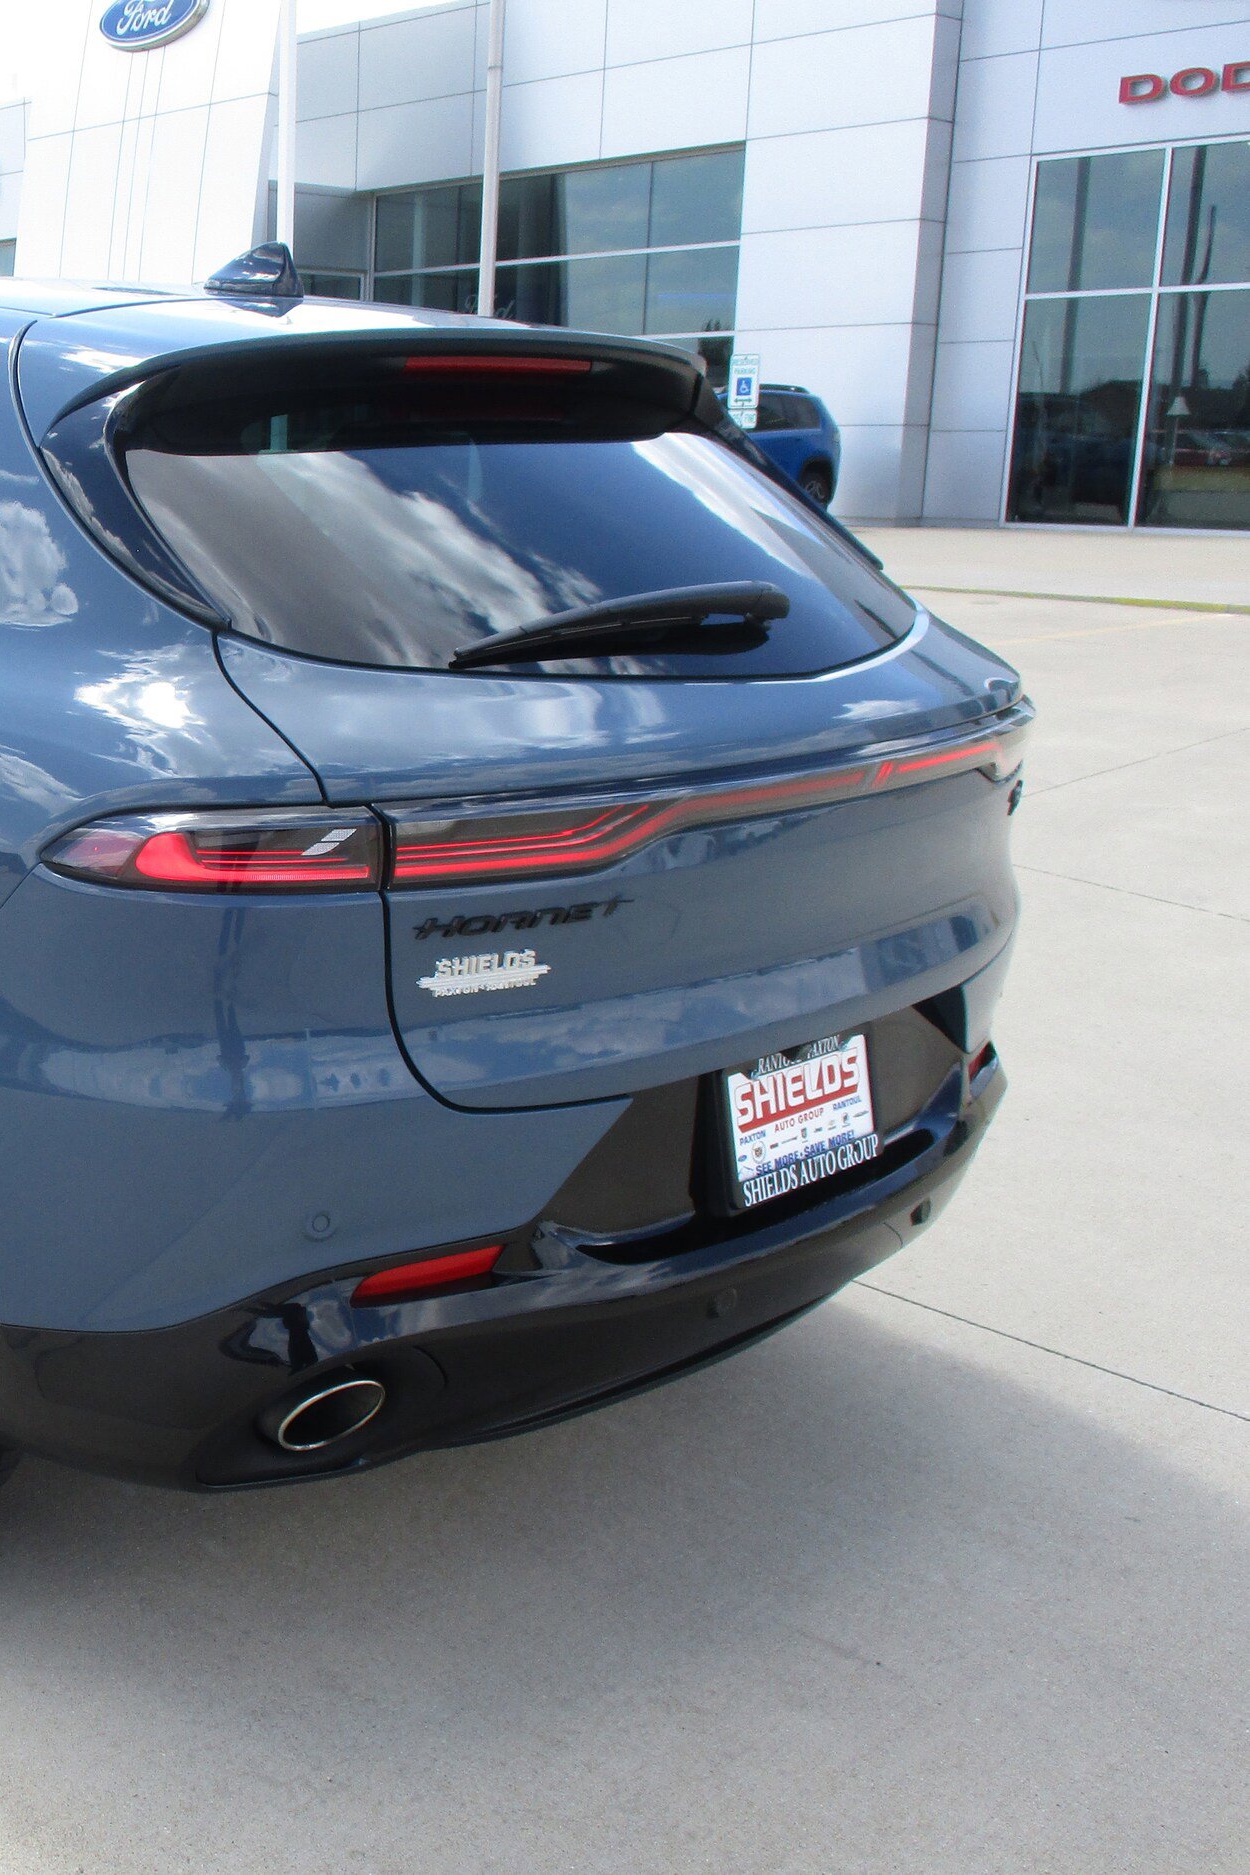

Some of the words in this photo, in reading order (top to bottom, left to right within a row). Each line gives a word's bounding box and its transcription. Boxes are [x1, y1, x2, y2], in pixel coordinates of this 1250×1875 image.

[116, 0, 175, 35] Ford
[412, 894, 635, 940] HORNET
[435, 949, 537, 978] SHIELDS
[734, 1048, 861, 1130] SHIELDS
[739, 1130, 767, 1146] PAXTON
[774, 1118, 796, 1133] AUTO
[797, 1107, 824, 1125] GROUP
[743, 1163, 798, 1208] SHIELDS
[800, 1153, 837, 1186] AUTO
[837, 1134, 879, 1170] GROUP
[755, 1161, 773, 1176] SEE
[803, 1141, 826, 1158] SAVE
[827, 1130, 856, 1148] MORE!
